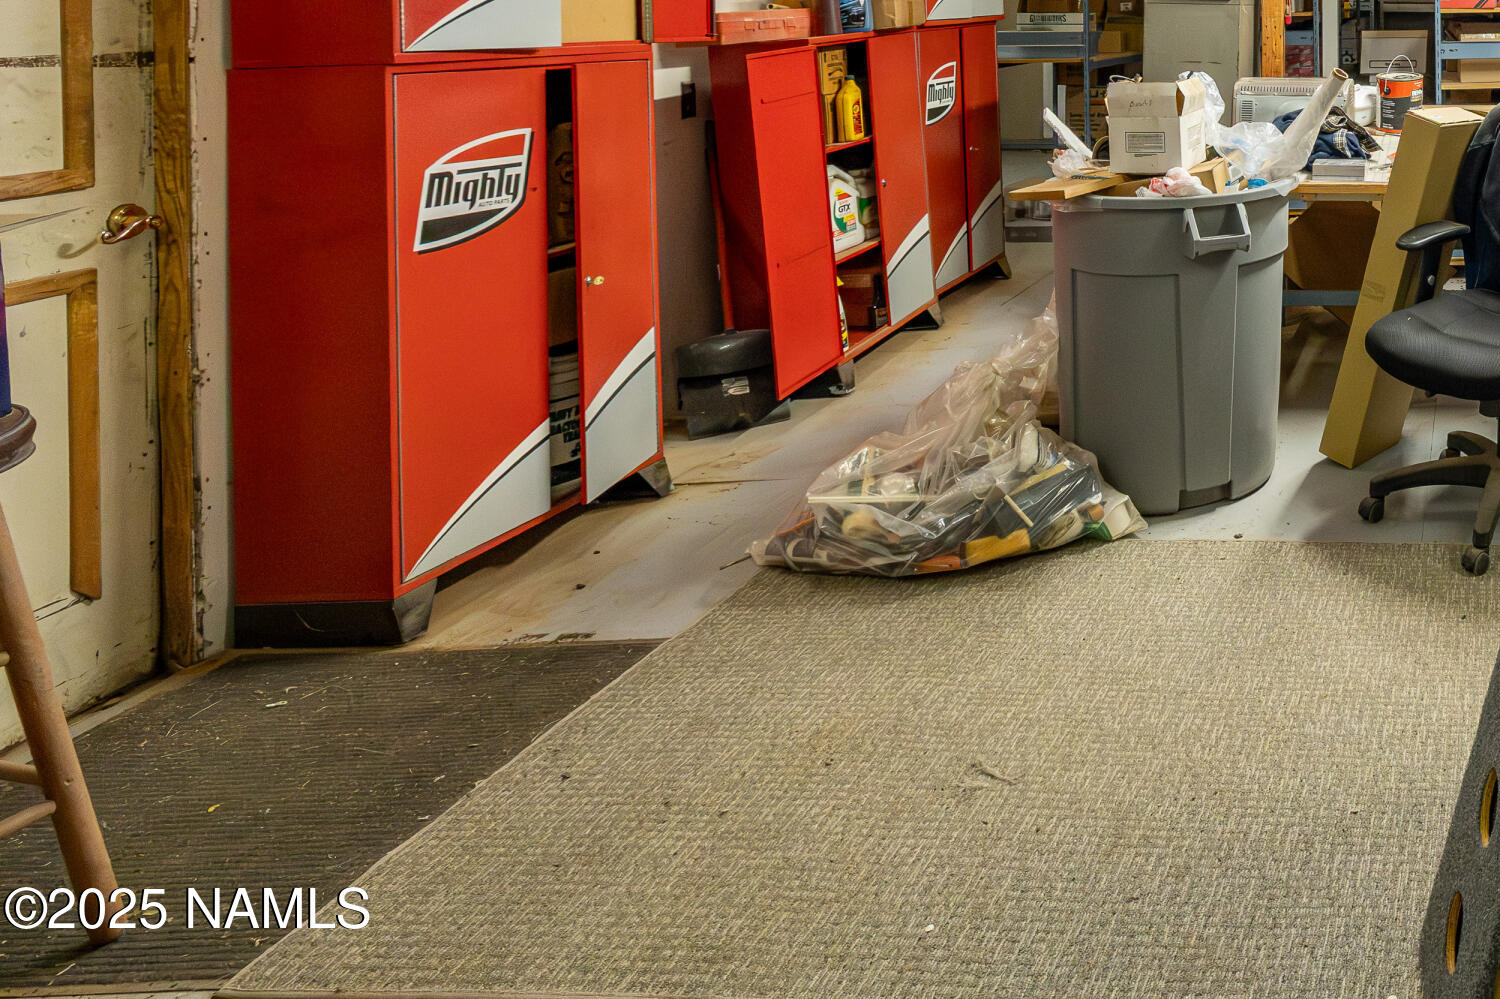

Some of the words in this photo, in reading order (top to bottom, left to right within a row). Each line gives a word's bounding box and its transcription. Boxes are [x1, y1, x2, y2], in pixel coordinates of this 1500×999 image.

[927, 80, 954, 104] Mighty
[425, 162, 522, 210] Mighty
[838, 203, 851, 213] GTX
